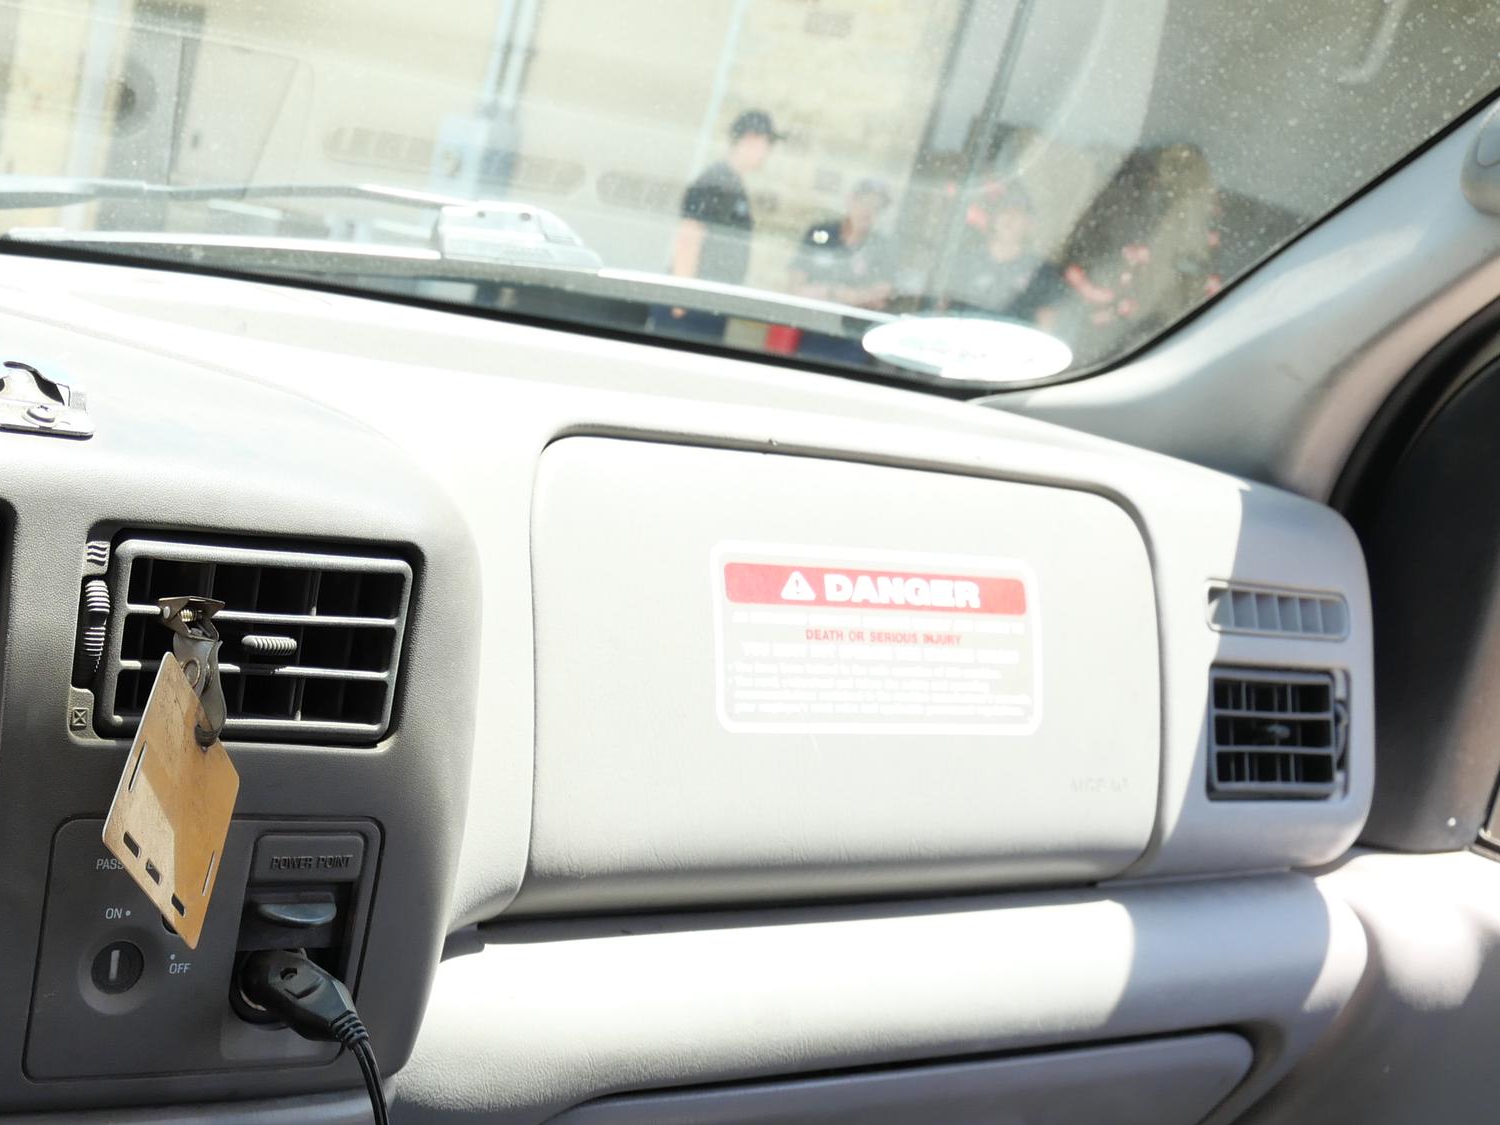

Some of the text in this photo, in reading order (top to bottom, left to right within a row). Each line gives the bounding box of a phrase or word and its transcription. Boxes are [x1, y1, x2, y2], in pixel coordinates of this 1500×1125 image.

[823, 573, 981, 609] DANGER
[805, 628, 963, 646] DEATH OR SERIOUS INJURY
[270, 854, 354, 870] POWER POINT
[105, 908, 123, 919] ON
[169, 963, 191, 974] OFF
